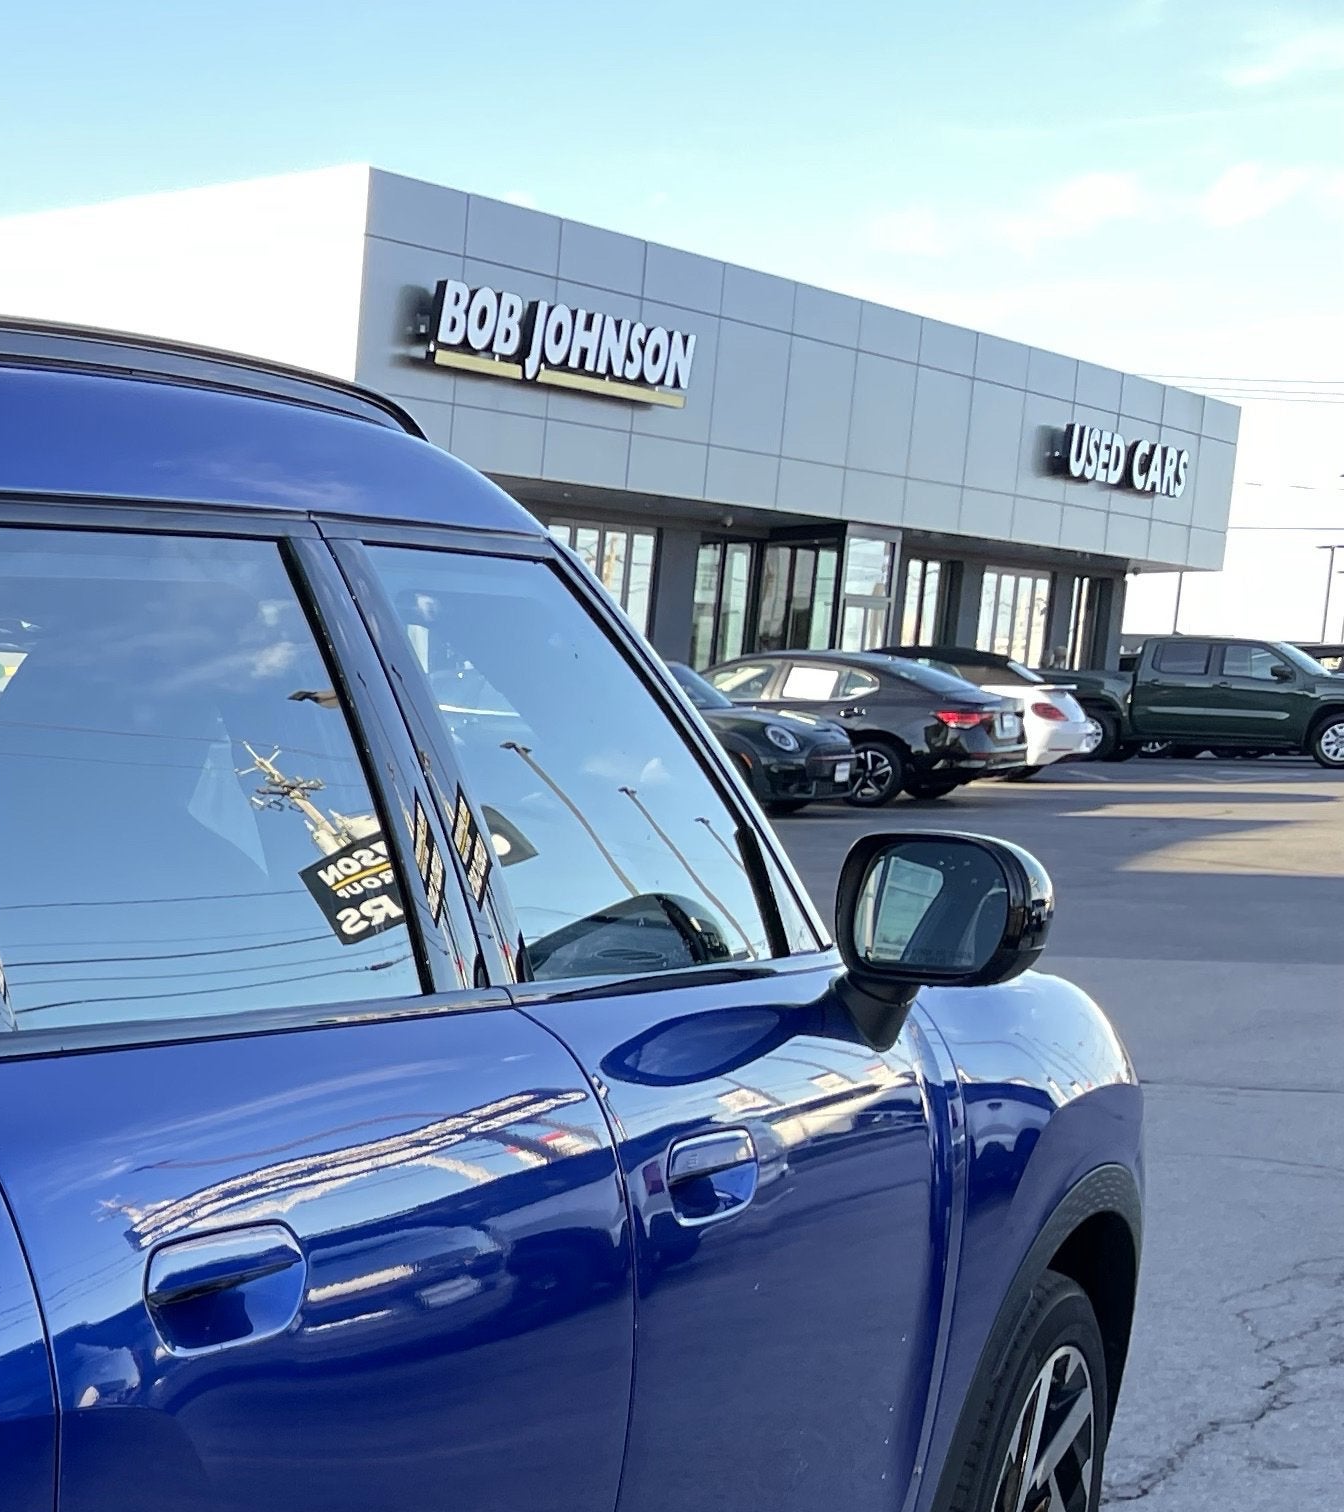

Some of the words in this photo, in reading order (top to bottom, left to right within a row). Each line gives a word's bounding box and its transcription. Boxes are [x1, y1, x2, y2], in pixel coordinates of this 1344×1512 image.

[437, 279, 524, 356] BOB
[525, 300, 697, 390] JOHNSON
[1069, 422, 1126, 485] USED
[1132, 439, 1189, 498] CARS
